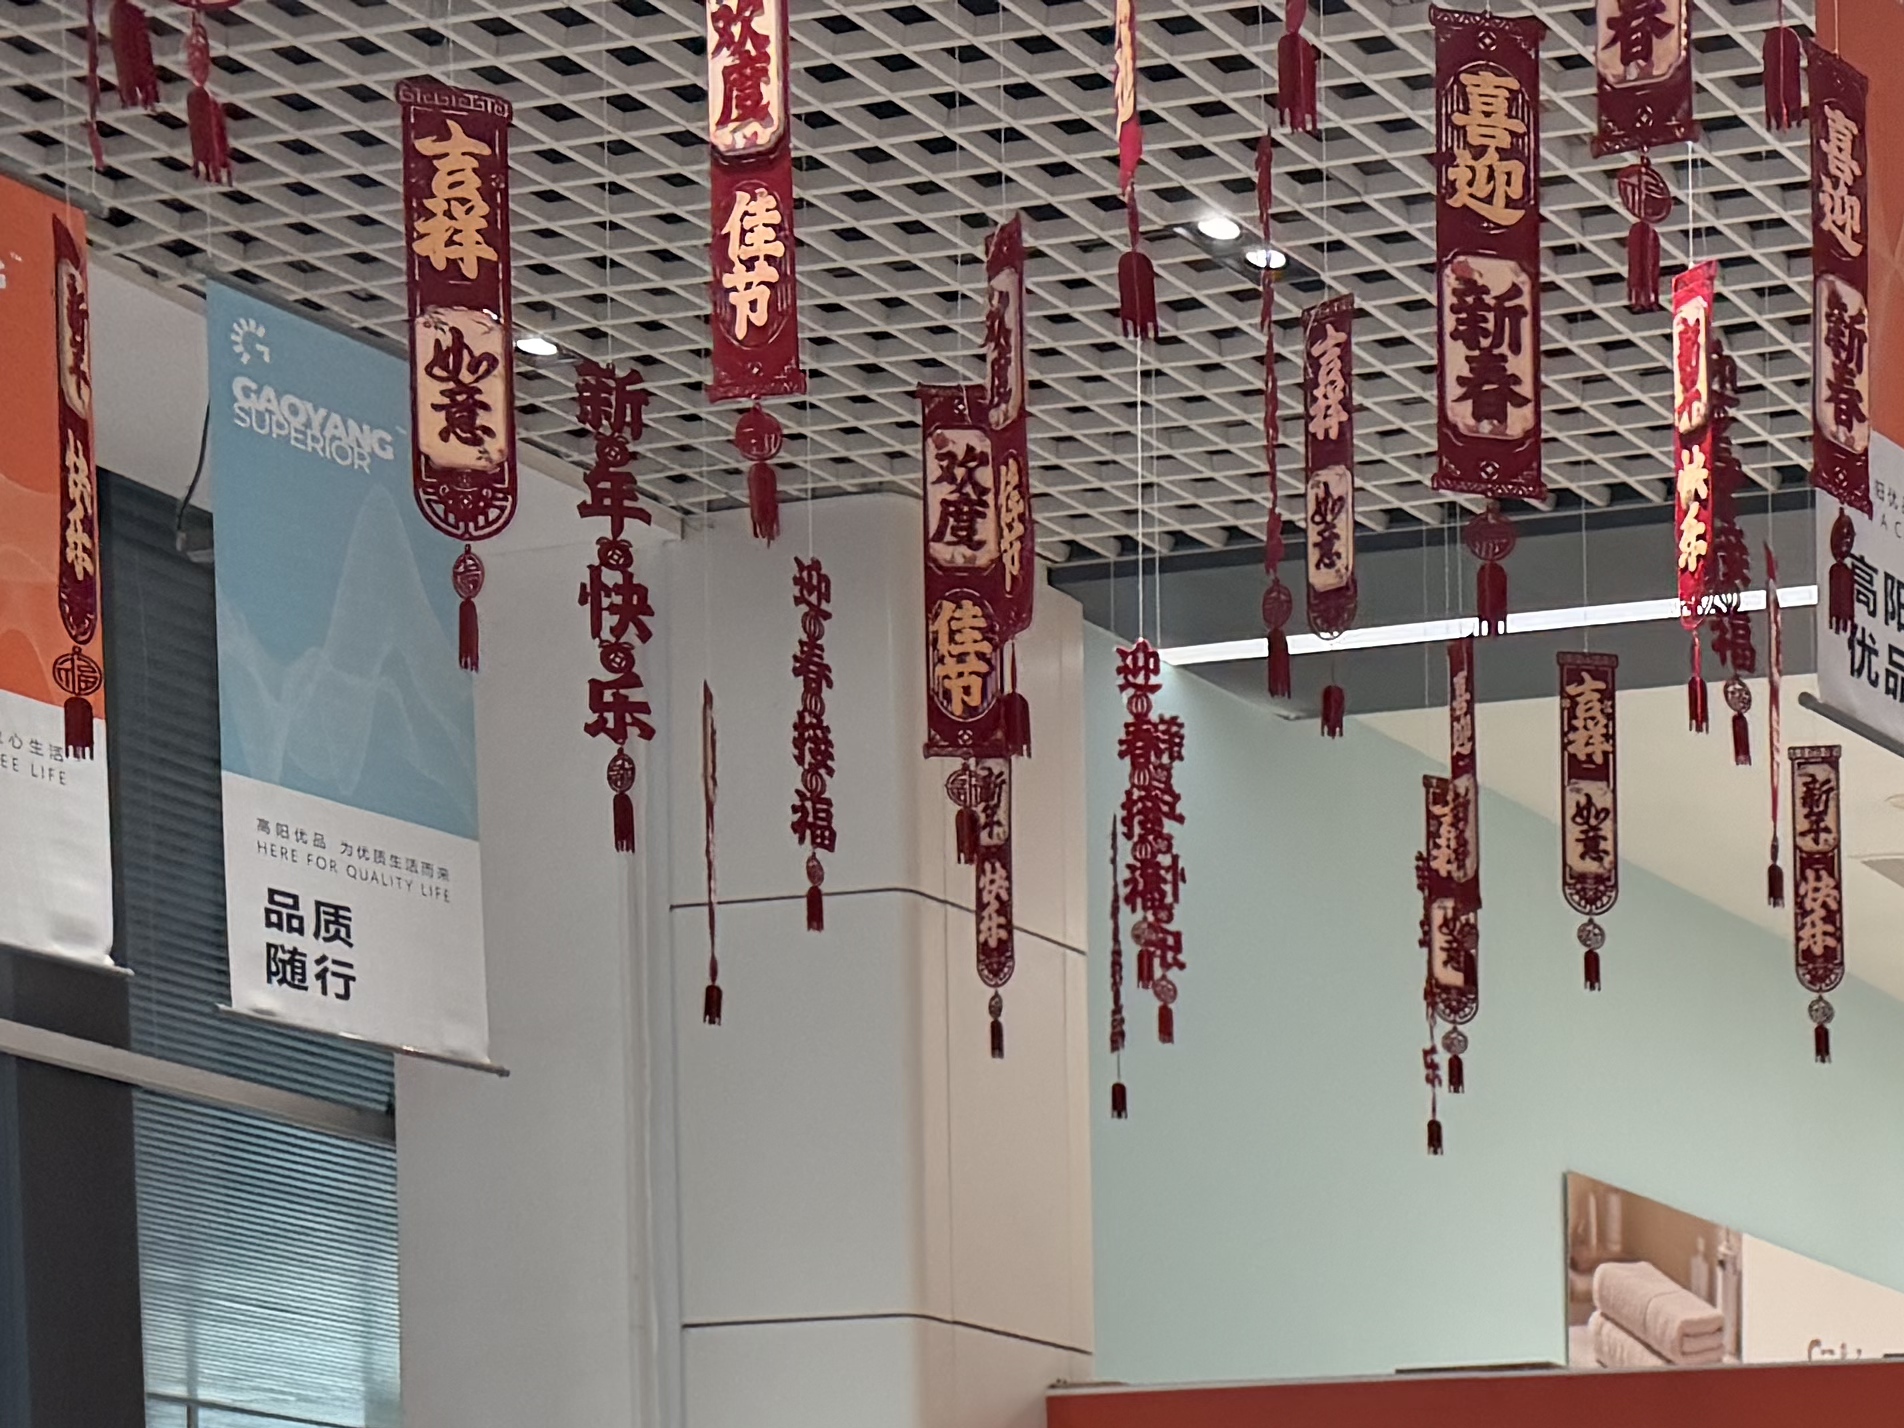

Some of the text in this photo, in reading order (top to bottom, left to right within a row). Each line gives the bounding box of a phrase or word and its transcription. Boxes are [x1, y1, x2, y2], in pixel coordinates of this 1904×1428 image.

[412, 120, 500, 447] 吉祥如意
[1446, 72, 1533, 423] 喜迎新春
[1818, 105, 1867, 436] 喜迎新春
[232, 376, 395, 461] GAOYANG
[233, 402, 373, 474] SUPERIOR
[1309, 323, 1349, 570] 吉祥如意
[575, 364, 656, 742] 新年快乐
[929, 443, 994, 717] 欢度佳节
[0, 730, 65, 763] 心生活
[30, 763, 67, 786] LIFE
[1565, 672, 1613, 864] 吉祥如意
[256, 841, 451, 904] HERE FOR QUALITY LIFE
[264, 887, 354, 948] 品质
[1798, 772, 1841, 956] 新年快乐
[265, 942, 357, 1001] 随行
